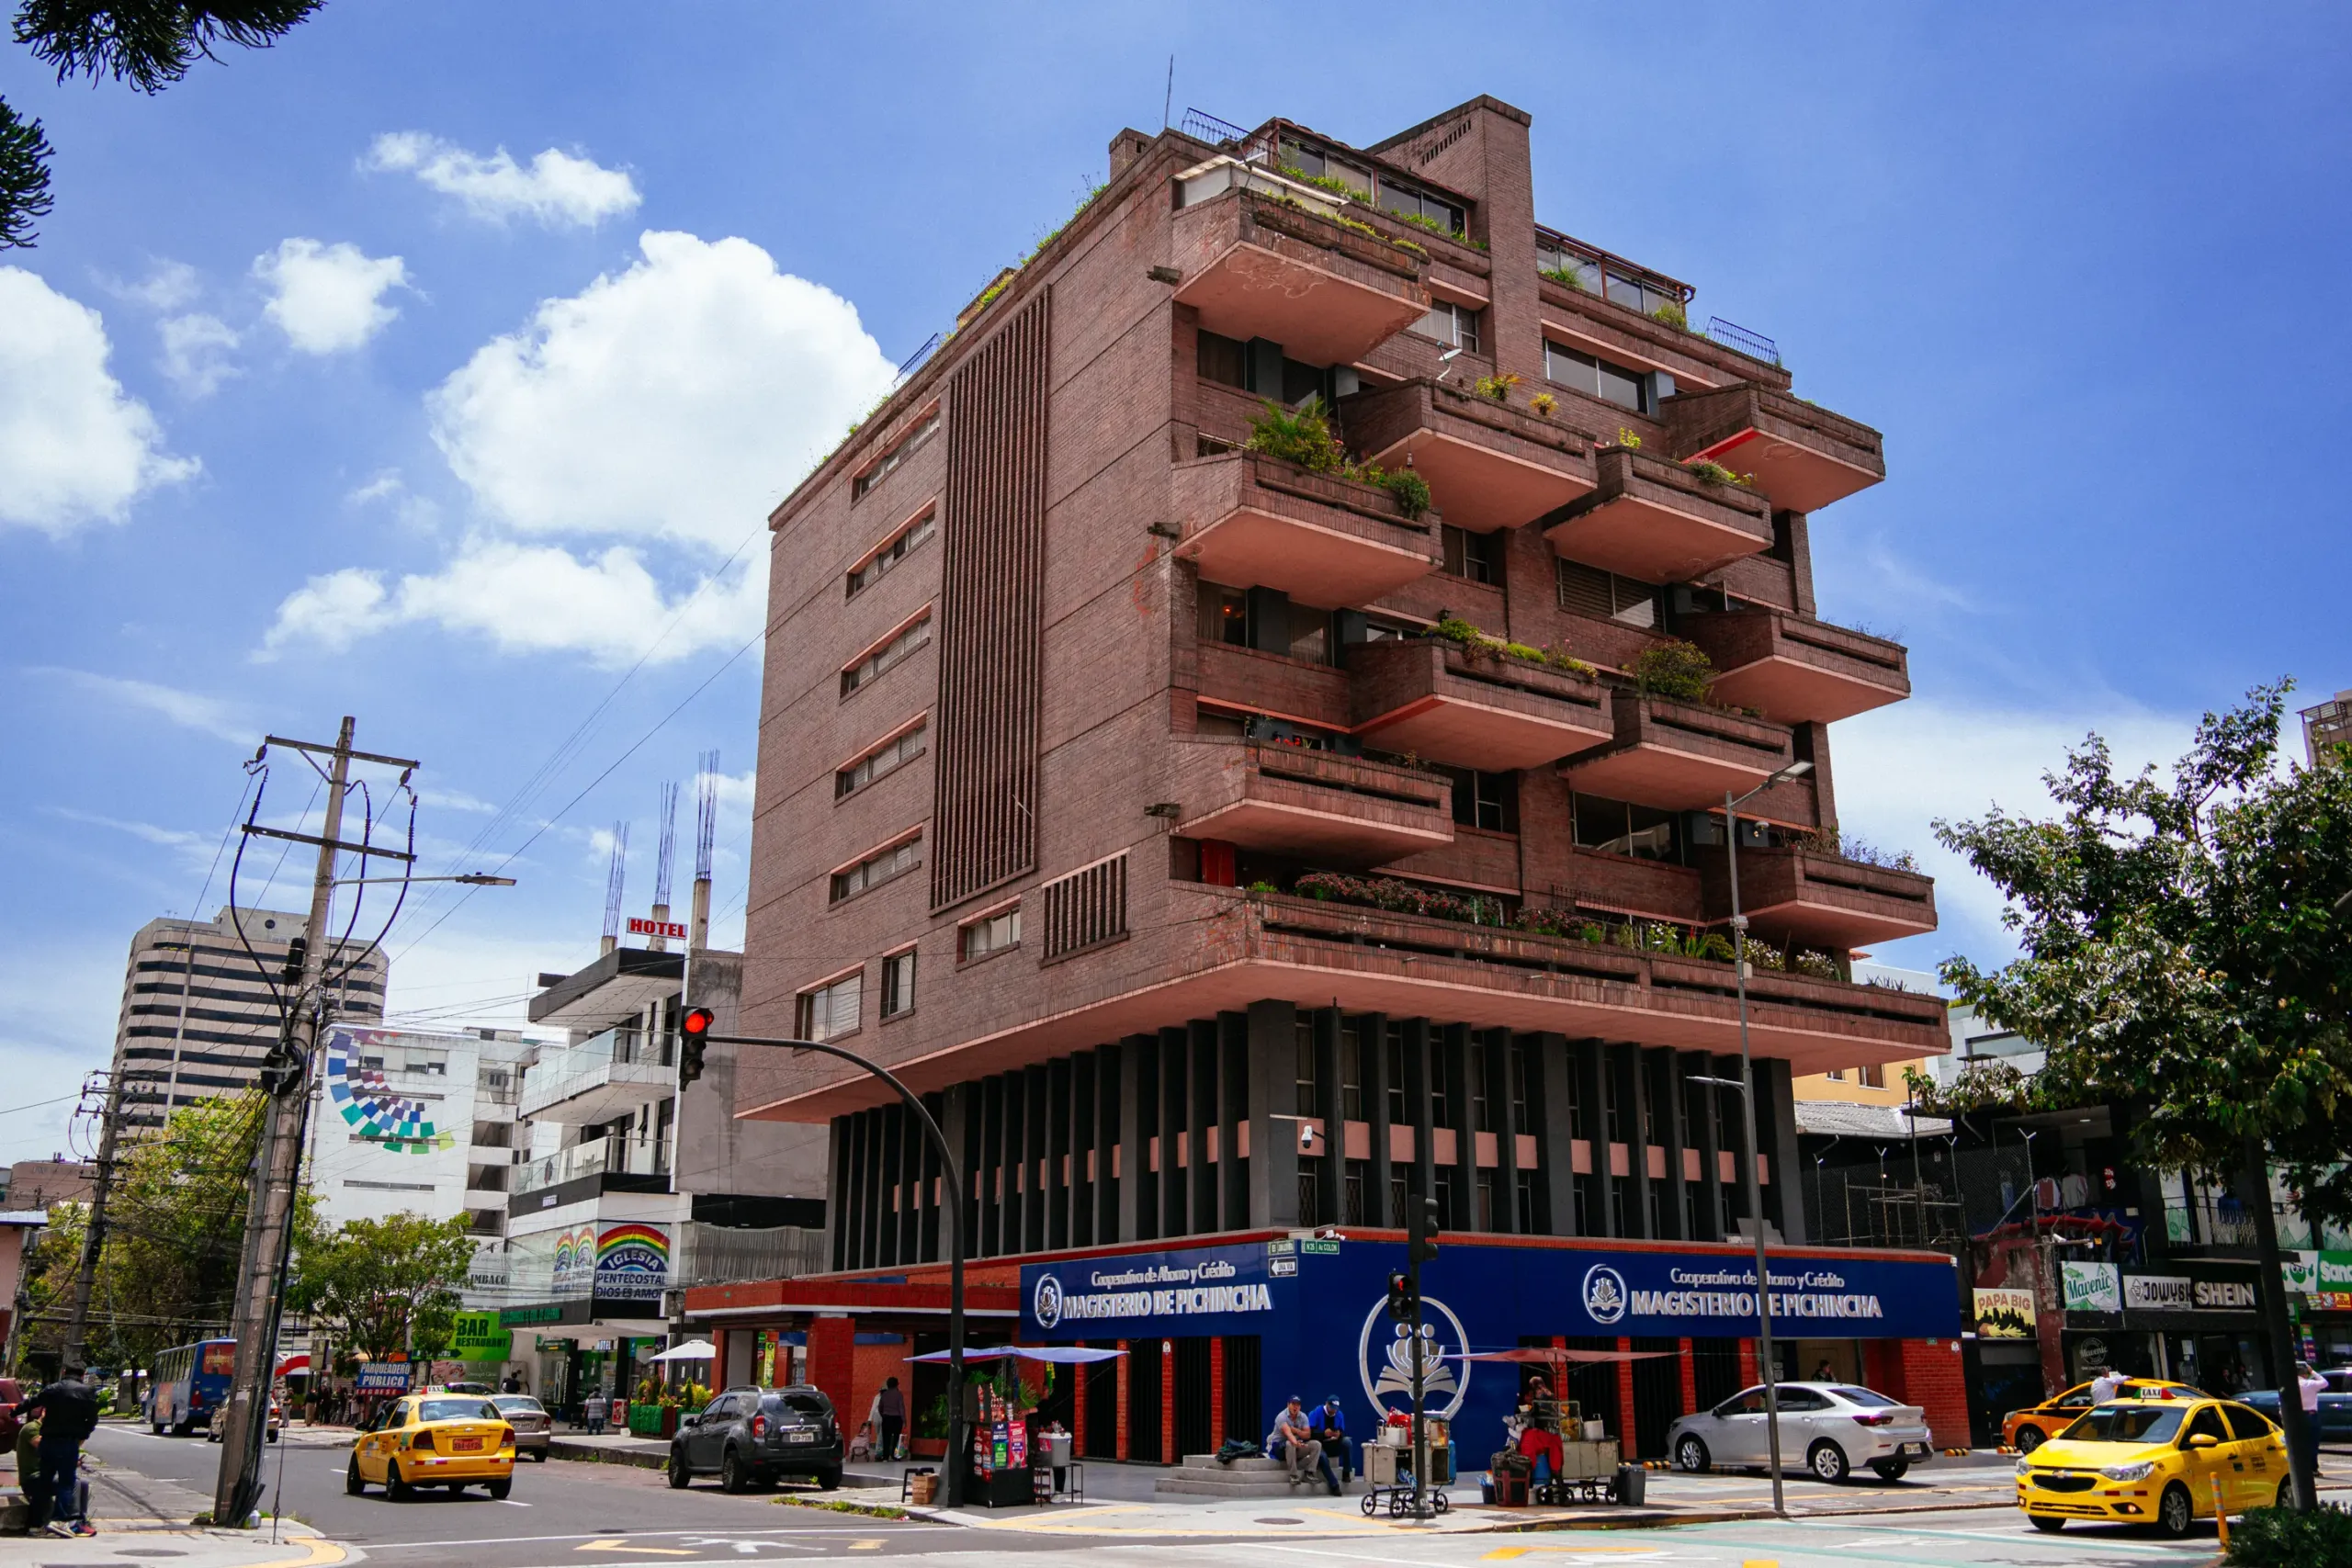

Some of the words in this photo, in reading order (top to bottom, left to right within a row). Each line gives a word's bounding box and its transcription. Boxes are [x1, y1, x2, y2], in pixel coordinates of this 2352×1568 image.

[629, 919, 685, 937] HOTEL
[607, 1251, 660, 1270] IGLESIA
[597, 1273, 666, 1285] PENTECOSTAL
[1091, 1269, 1144, 1290] Cooperativa
[1145, 1267, 1157, 1283] de
[1158, 1266, 1189, 1282] Ahorro
[1191, 1269, 1198, 1284] y
[1198, 1260, 1236, 1280] Crédito
[1670, 1268, 1741, 1288] Cooperativa
[1742, 1269, 1758, 1286] de
[1760, 1269, 1796, 1286] horro
[1796, 1276, 1804, 1291] y
[1804, 1271, 1845, 1288] Crédito
[596, 1287, 620, 1298] DIOS
[2067, 1273, 2111, 1300] Mavenic
[2195, 1280, 2256, 1305] SHEIN
[1063, 1291, 1152, 1319] MAGISTERIO
[1153, 1289, 1175, 1315] DE
[1175, 1283, 1272, 1314] PICHINCHA
[1631, 1290, 1754, 1316] MAGISTERIO
[1782, 1293, 1883, 1318] PICHINCHA
[1977, 1292, 2009, 1312] PAPA
[2011, 1293, 2031, 1312] BIG
[457, 1318, 489, 1337] BAR
[456, 1337, 507, 1348] RESTAURANT
[360, 1362, 411, 1375] PARQUEADERO
[362, 1375, 404, 1386] PUBLICO
[2143, 1388, 2161, 1396] TAXI
